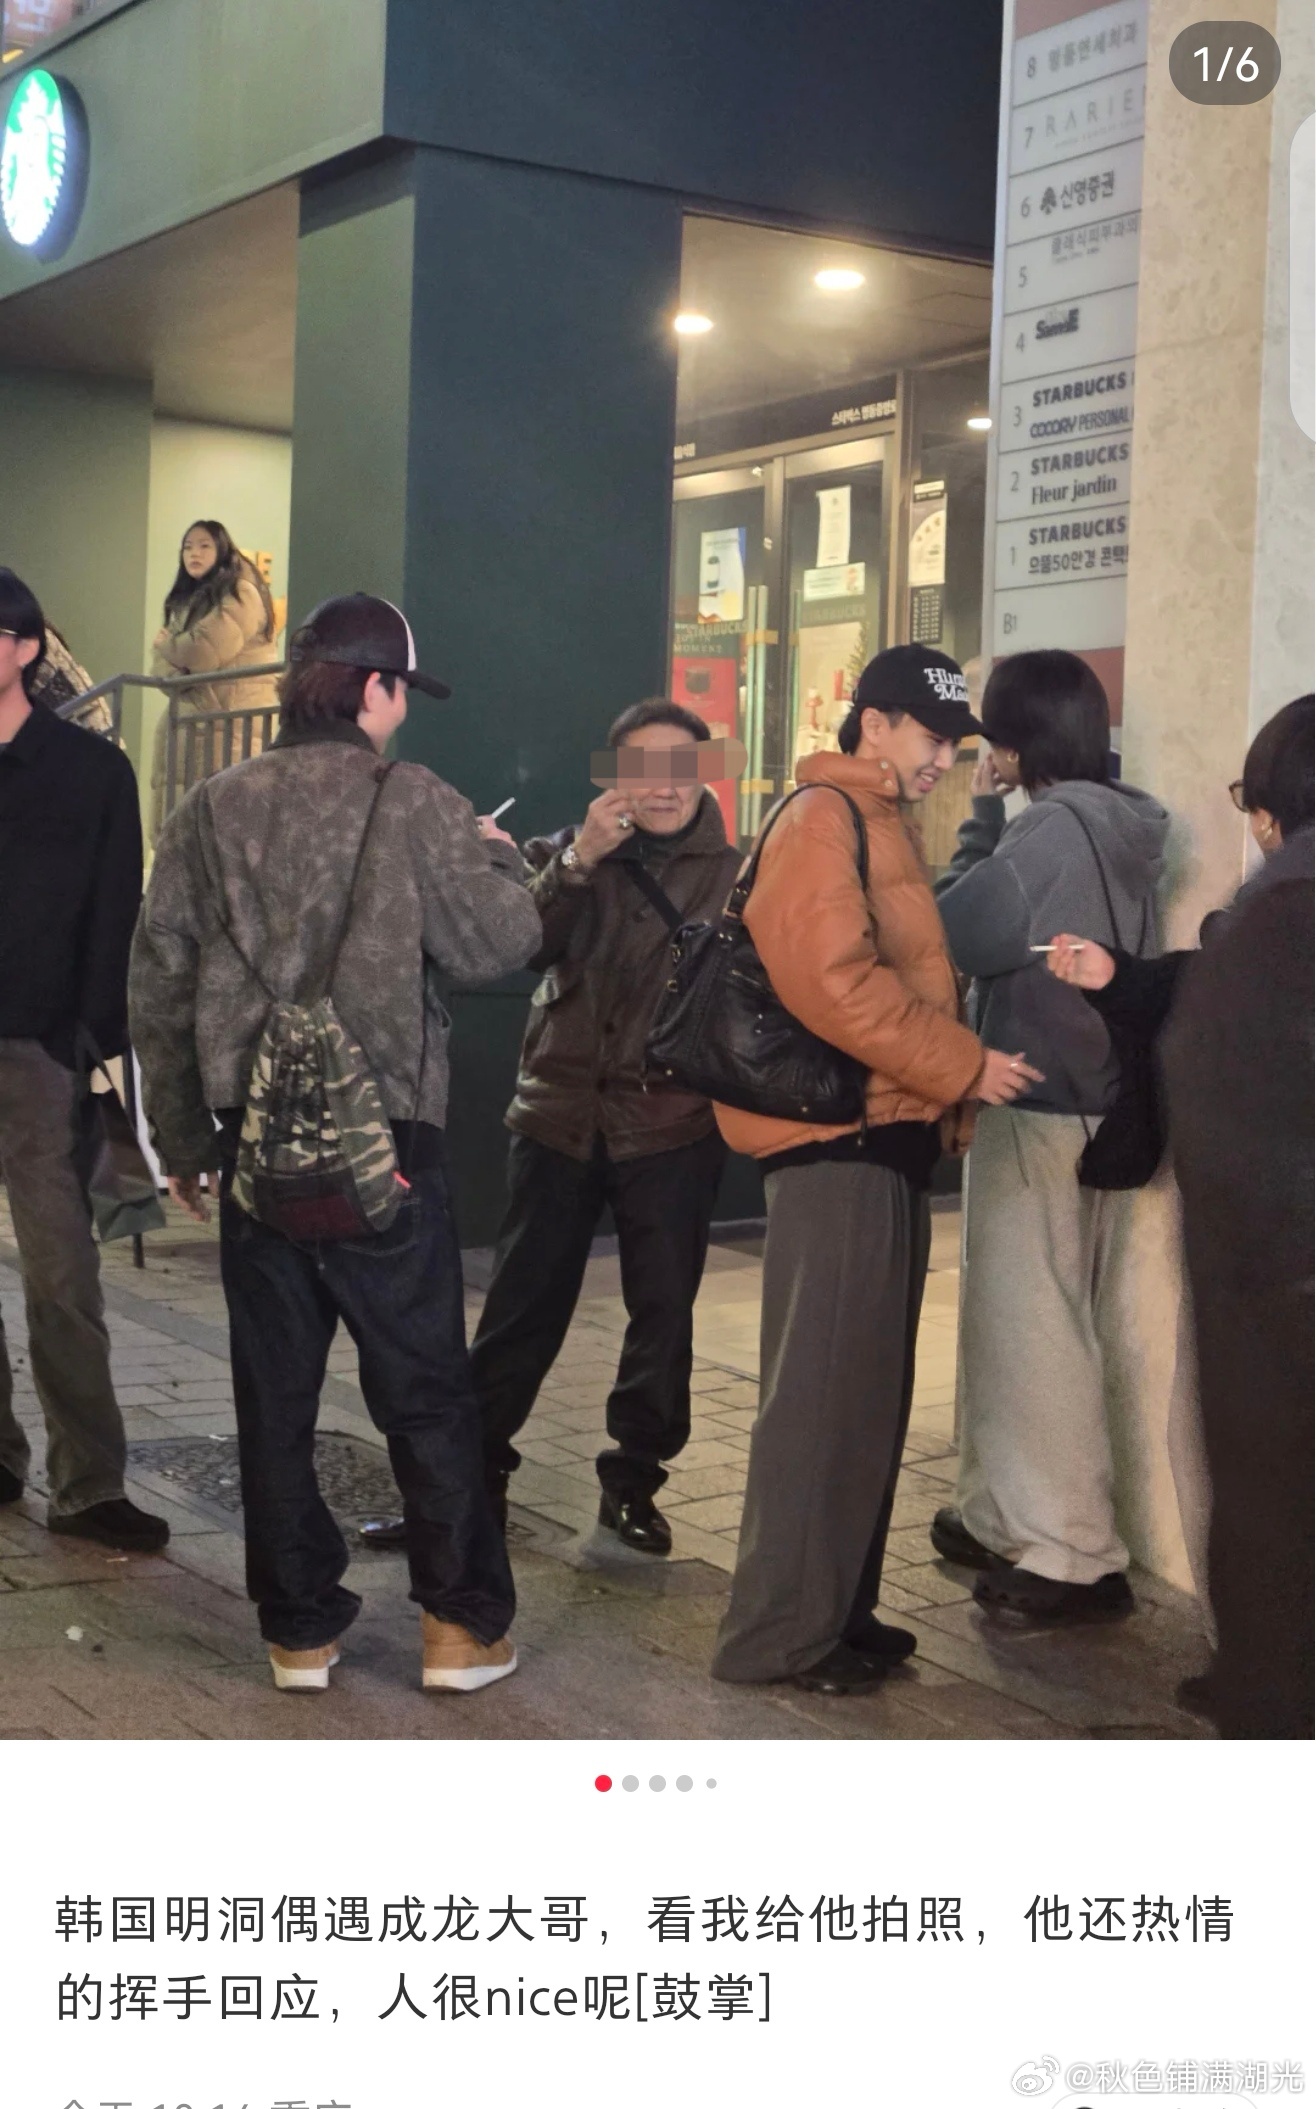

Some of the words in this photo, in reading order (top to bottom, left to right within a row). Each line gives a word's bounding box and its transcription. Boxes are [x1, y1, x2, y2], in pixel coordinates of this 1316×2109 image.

[1027, 56, 1037, 79] 8
[1024, 126, 1034, 149] 7
[1045, 84, 1145, 137] RARIE
[1021, 196, 1031, 218] 6
[1060, 170, 1115, 210] 신영증권
[1018, 266, 1028, 288] 5
[1015, 332, 1025, 351] 4
[1032, 371, 1127, 408] STARBUCKS
[1013, 405, 1022, 428] 3
[1078, 406, 1130, 431] PERSONAL
[1030, 442, 1130, 476] STARBUCKS
[1010, 471, 1020, 492] 2
[1031, 485, 1069, 506] Fleur
[1070, 474, 1118, 503] jardin
[1028, 515, 1127, 546] STARBUCKS
[1010, 546, 1016, 567] 1
[1028, 548, 1096, 574] 으뜸50안경
[1100, 544, 1129, 568] 콘택
[1003, 612, 1018, 635] B1
